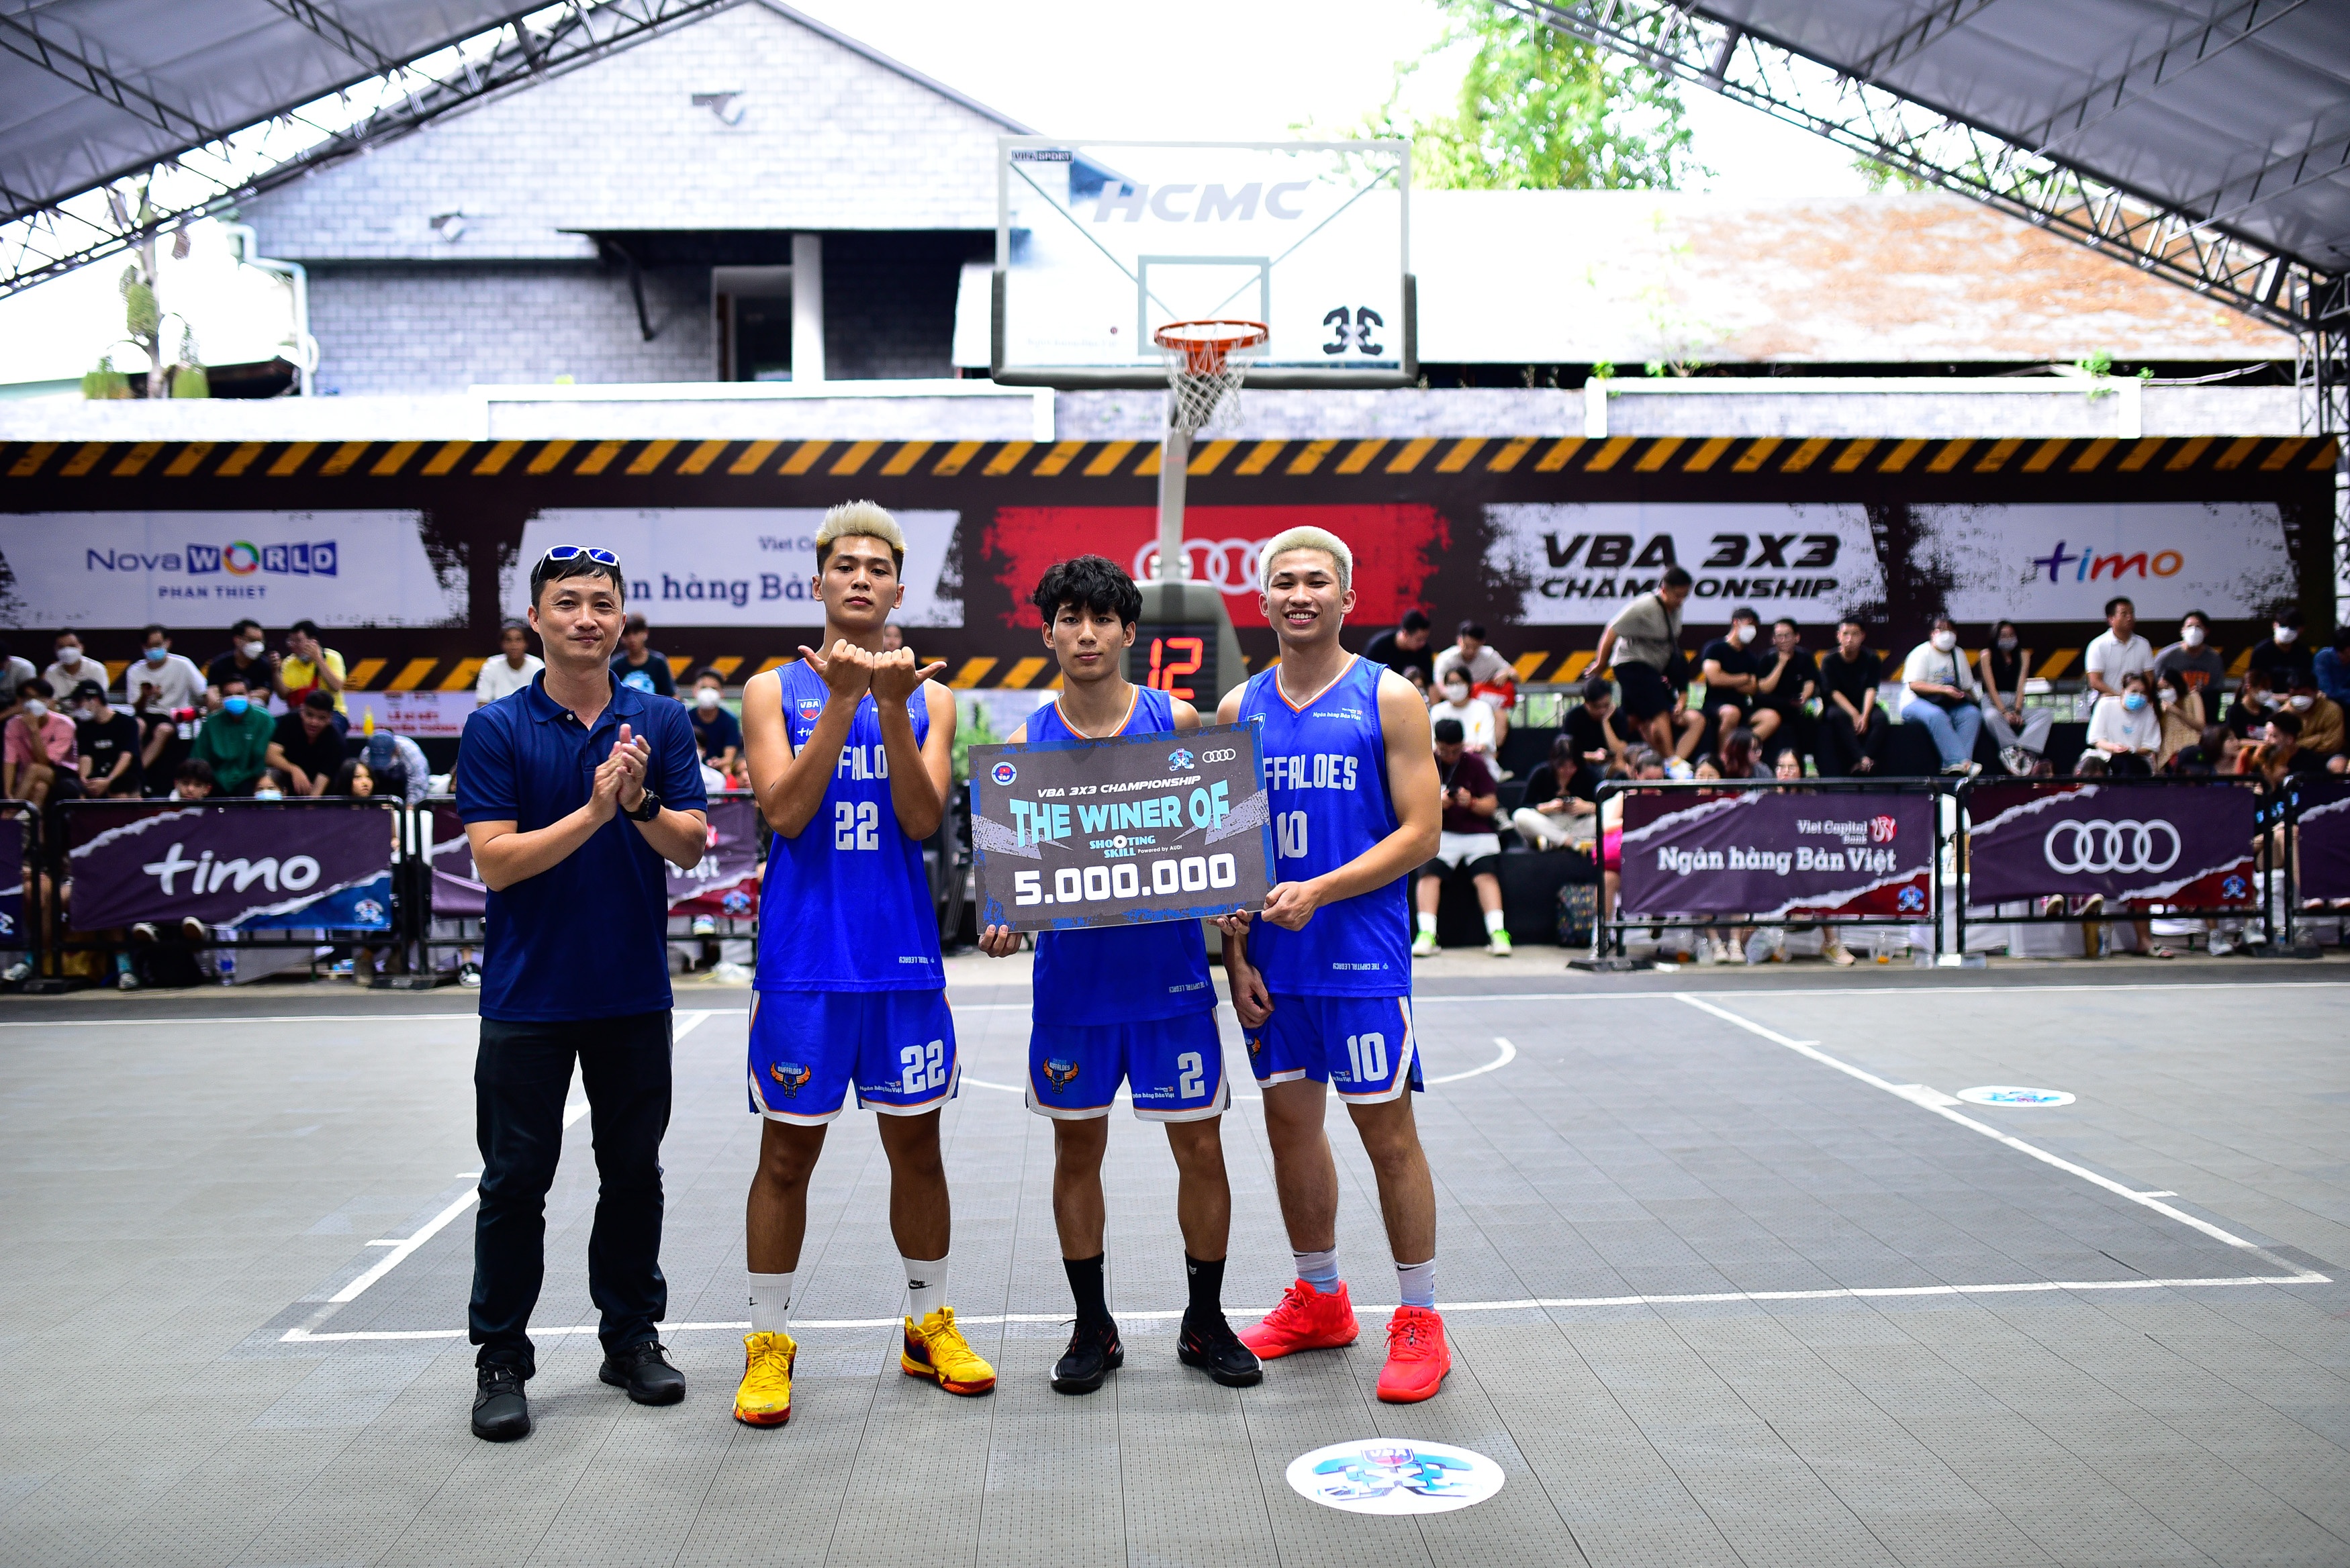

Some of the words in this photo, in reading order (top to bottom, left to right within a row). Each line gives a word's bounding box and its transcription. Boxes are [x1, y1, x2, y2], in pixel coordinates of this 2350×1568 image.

[1093, 180, 1313, 222] HCMC
[1545, 534, 1677, 569] VBA
[1702, 534, 1840, 569] 3X3
[2033, 540, 2183, 583] timo
[158, 586, 207, 597] PHAN
[215, 586, 267, 597] THIET
[663, 574, 750, 607] hàng
[1541, 579, 1838, 598] CHAMONSHIP
[1147, 638, 1203, 699] 12
[1037, 787, 1066, 798] VBA
[1069, 785, 1096, 796] 3X3
[1100, 775, 1201, 793] CHAMPIONSHIP
[1264, 754, 1358, 791] FFALOES
[835, 801, 878, 850] 22
[1009, 798, 1072, 848] THE
[1077, 795, 1183, 834] WINER
[1188, 779, 1230, 830] OF
[1797, 820, 1821, 834] Viet
[1824, 820, 1868, 836] Capital
[1089, 834, 1156, 849] SHOOTING
[1137, 846, 1160, 854] Powered
[1277, 810, 1307, 859] 10
[142, 842, 321, 895] timo
[1104, 847, 1136, 858] SKILL
[1658, 846, 1724, 875] Ngân
[1730, 846, 1793, 875] hàng
[1796, 846, 1845, 871] Bản
[1846, 847, 1897, 875] Việt
[1015, 852, 1236, 905] 5.000.000
[1351, 963, 1370, 971] CAPITAL
[778, 1067, 802, 1075] BUFFALOES
[900, 1039, 945, 1095] 22
[1347, 1032, 1389, 1082] 10
[1177, 1051, 1205, 1099] 2
[910, 1279, 925, 1287] NIKE
